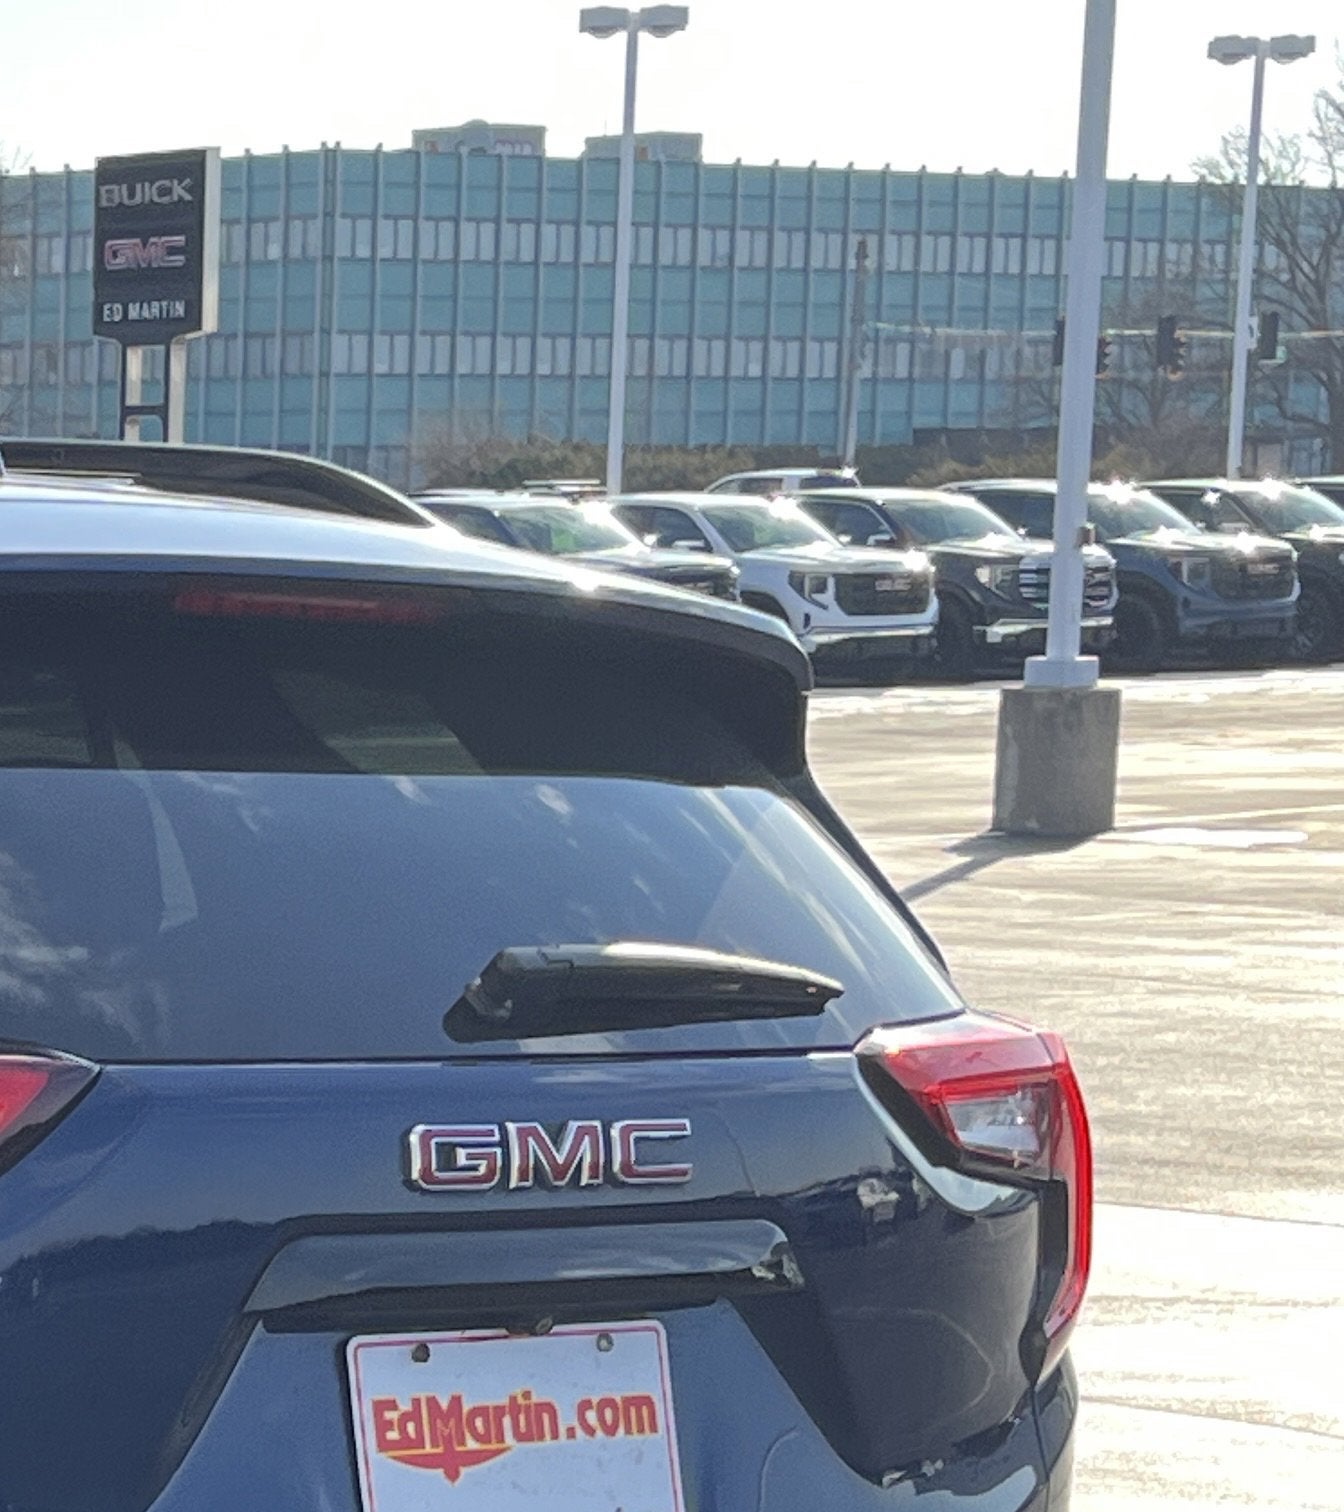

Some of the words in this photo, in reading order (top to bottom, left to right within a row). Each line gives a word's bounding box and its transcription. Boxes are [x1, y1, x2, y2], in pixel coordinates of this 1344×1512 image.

[98, 178, 193, 208] BUICK
[104, 235, 186, 271] GMC
[102, 302, 123, 322] ED
[127, 300, 186, 321] MARTIN
[409, 1118, 693, 1191] GMC
[371, 1389, 660, 1453] EdMartin.com
